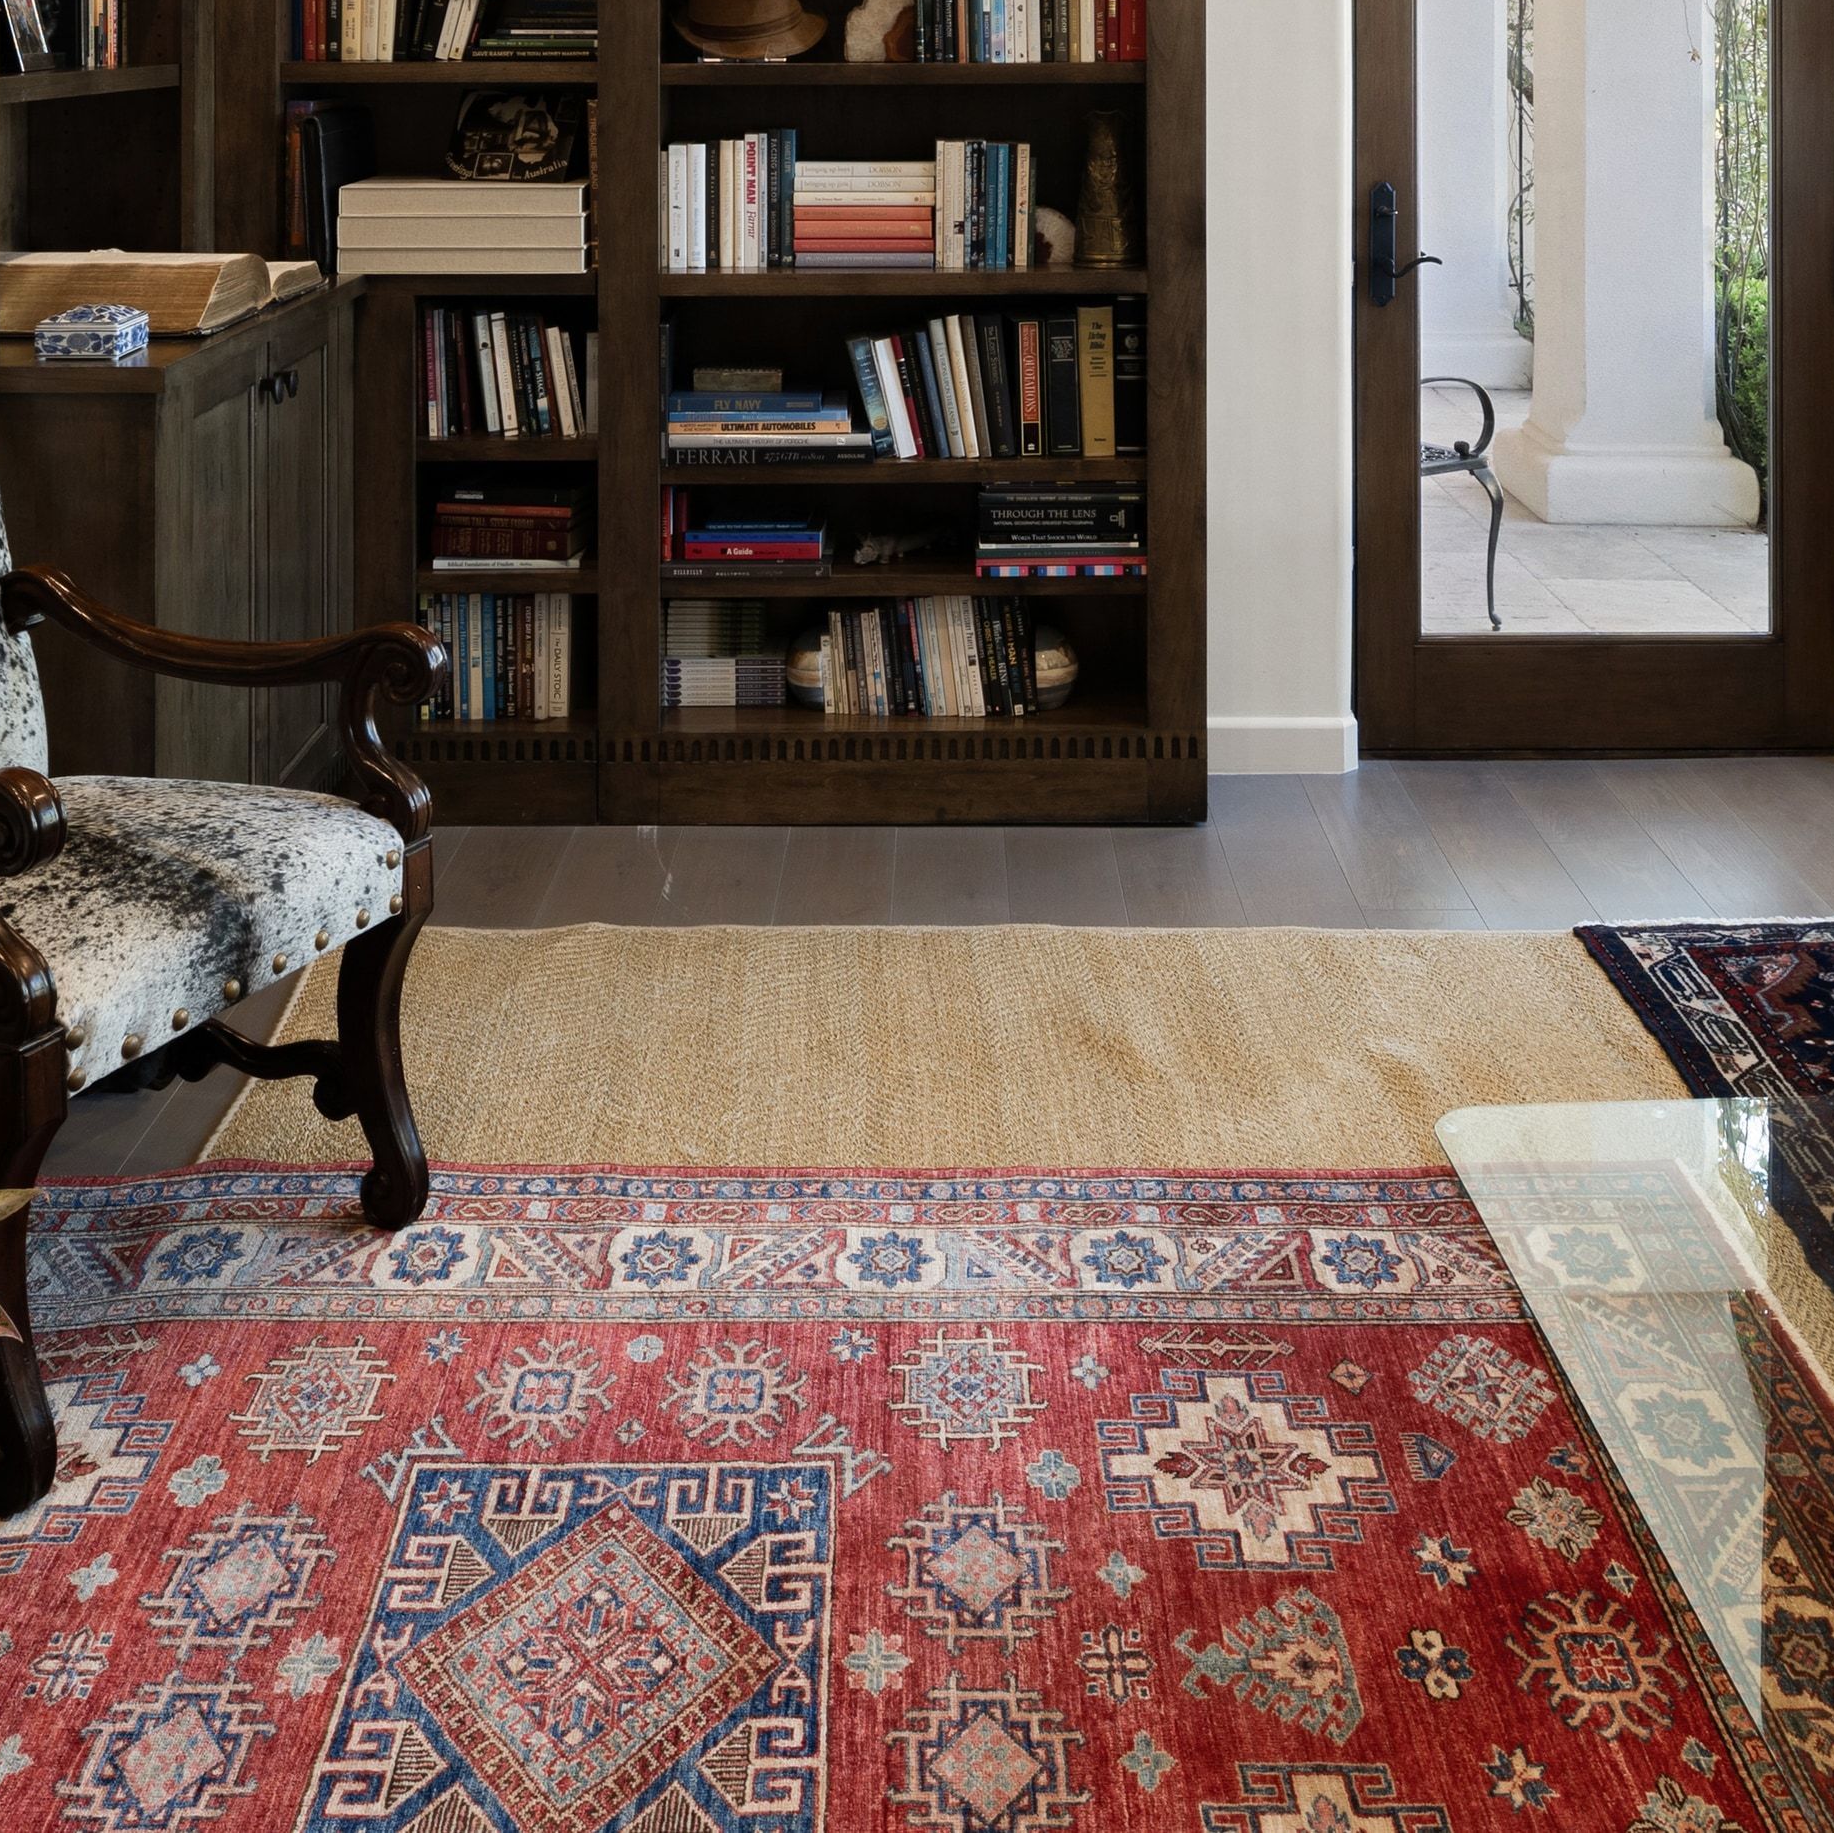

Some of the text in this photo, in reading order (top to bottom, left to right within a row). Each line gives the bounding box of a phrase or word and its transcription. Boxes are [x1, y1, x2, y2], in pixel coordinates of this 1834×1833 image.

[1060, 18, 1068, 33] GOD
[1095, 11, 1105, 44] WEBER
[770, 138, 779, 204] FACING TERROR
[868, 165, 902, 174] DOBSON
[746, 141, 758, 240] POINT MAN Farrar
[536, 372, 547, 399] SHACK
[1023, 355, 1038, 412] QUOTATIONS
[713, 400, 762, 411] FLY NAVY
[720, 422, 817, 432] ULTIMATE AUTOMOBILES
[675, 448, 758, 465] FERRARI
[989, 508, 1097, 520] THROUGH THE LENS
[733, 547, 753, 556] Guide
[552, 647, 563, 700] DAILY STOIC
